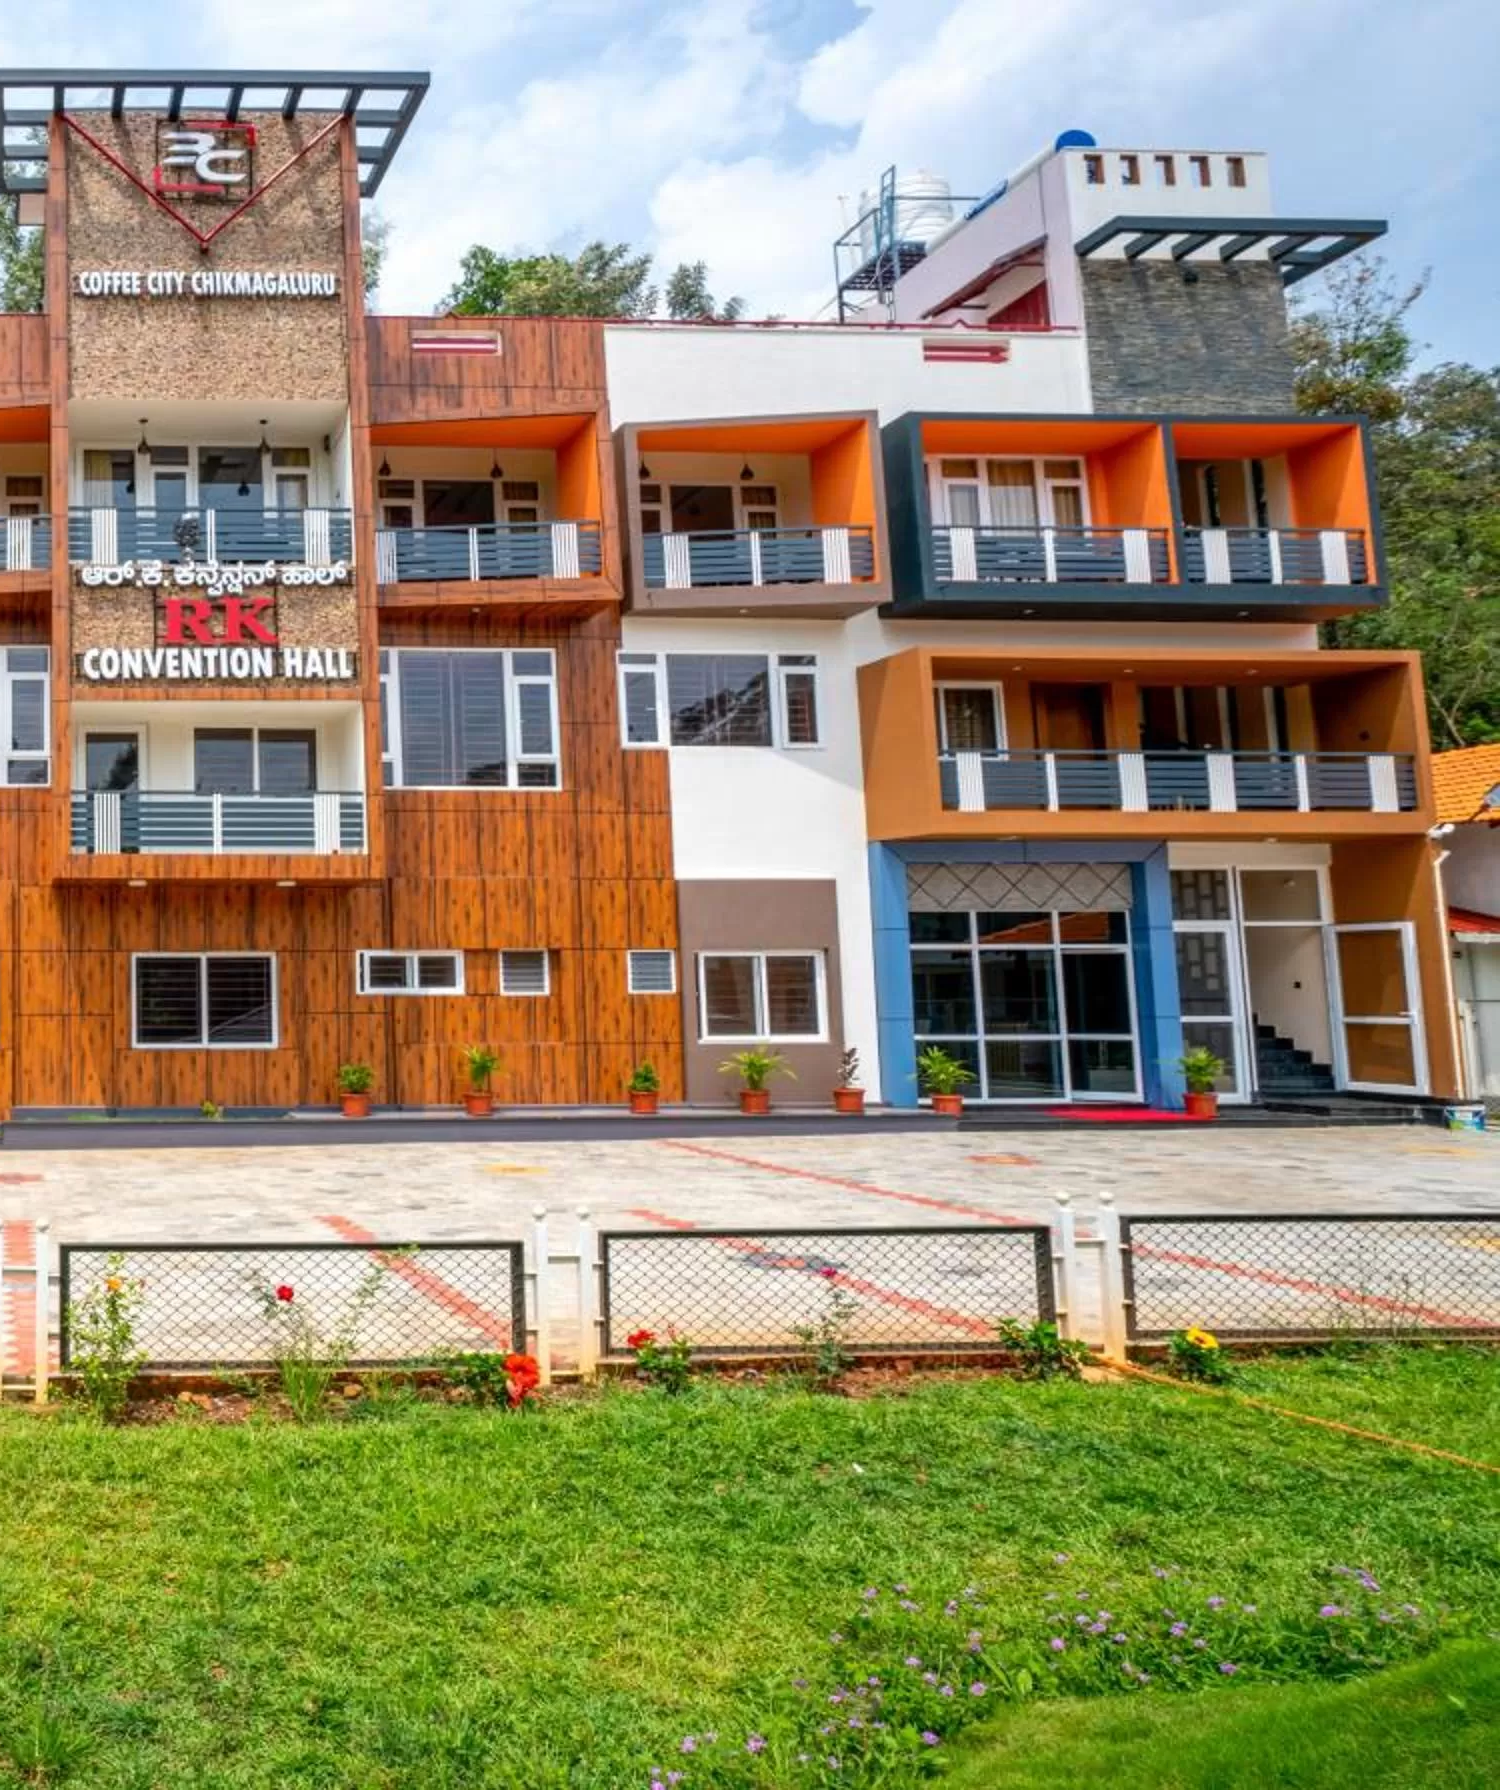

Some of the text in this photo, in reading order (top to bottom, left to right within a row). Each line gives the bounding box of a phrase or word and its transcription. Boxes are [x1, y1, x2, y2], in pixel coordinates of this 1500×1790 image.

[79, 271, 336, 296] COFFEE CITY CHIKMAGALURU
[162, 596, 279, 645] RK
[83, 647, 353, 680] CONVENTION HALL
